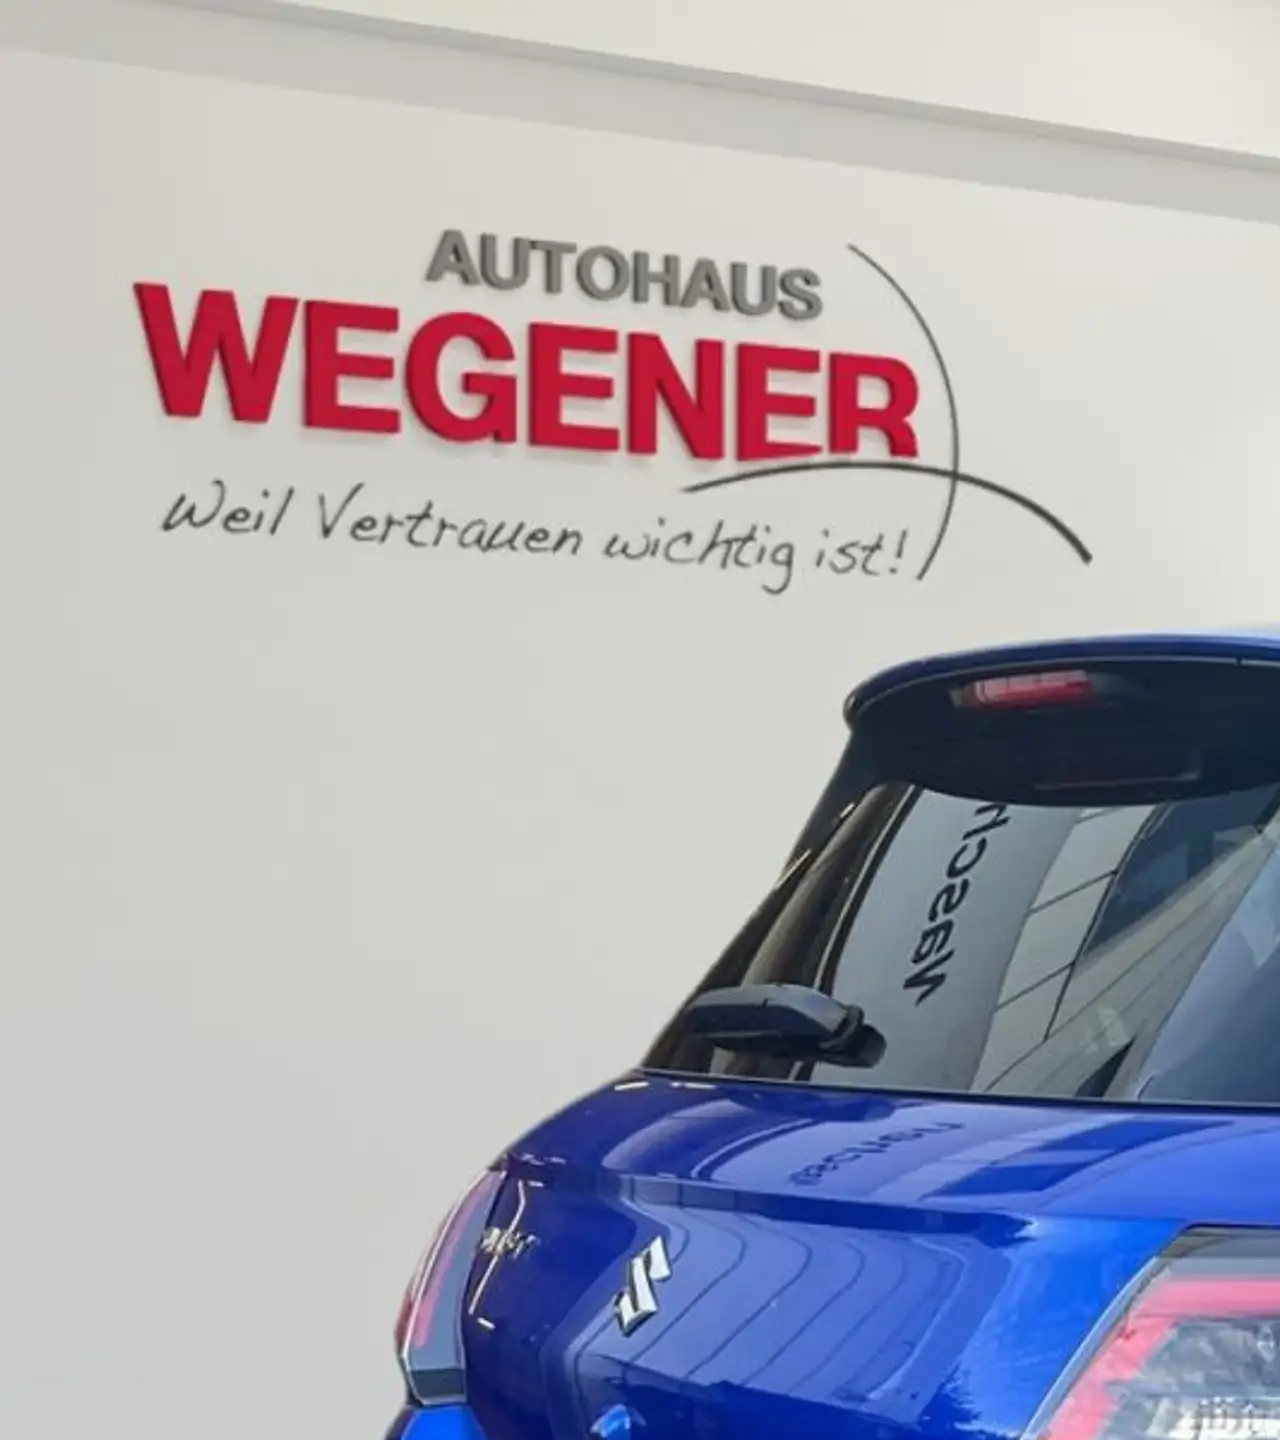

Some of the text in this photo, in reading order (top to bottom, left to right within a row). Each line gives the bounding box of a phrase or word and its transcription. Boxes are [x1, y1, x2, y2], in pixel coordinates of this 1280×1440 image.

[424, 229, 823, 322] AUTOHAUS
[134, 283, 919, 463] WEGENER
[162, 479, 907, 595] Weil Vertrauen wichtig ist!
